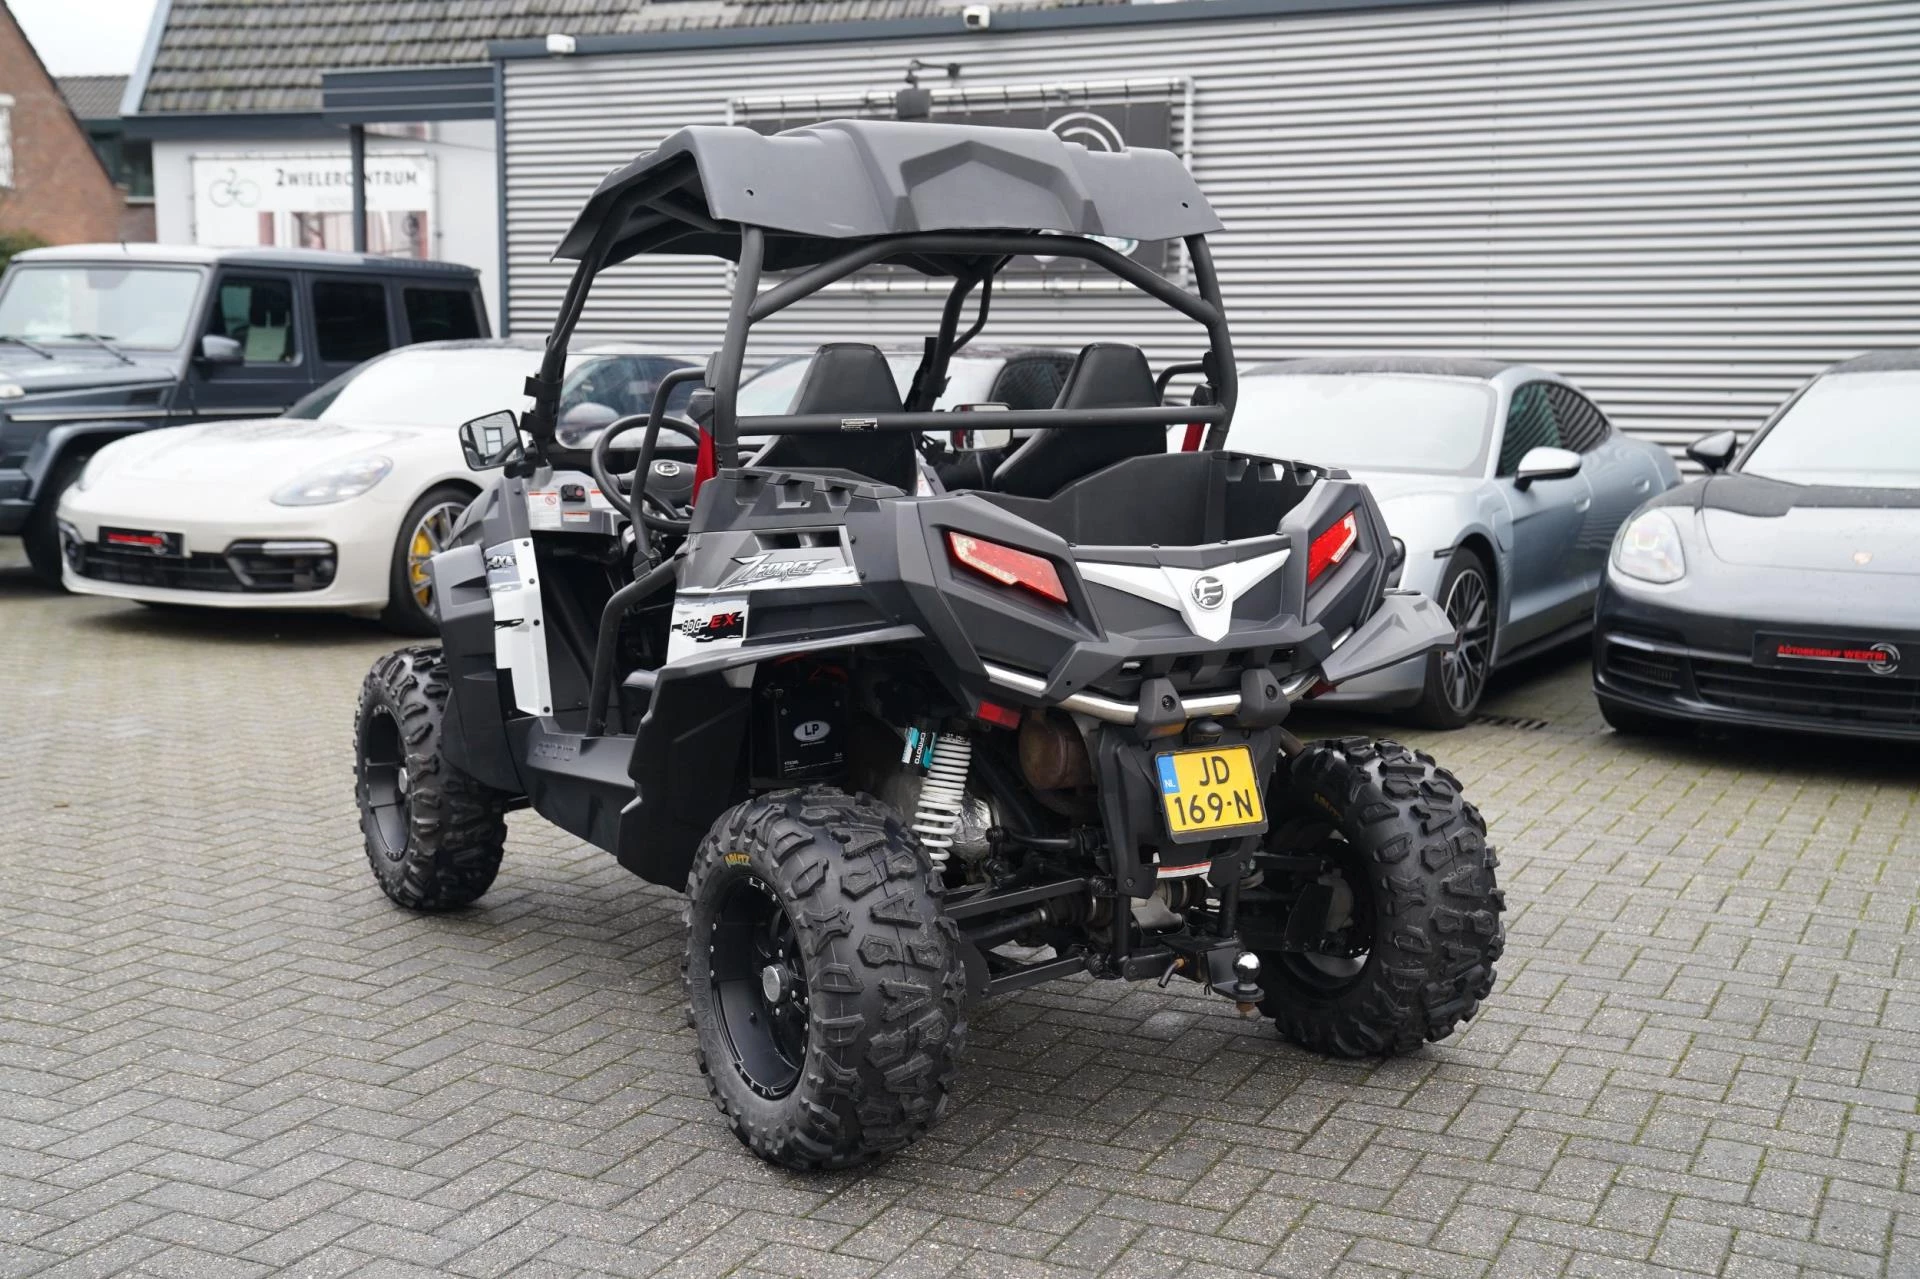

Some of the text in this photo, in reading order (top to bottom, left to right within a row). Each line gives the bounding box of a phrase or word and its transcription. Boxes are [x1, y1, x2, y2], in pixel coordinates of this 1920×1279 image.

[275, 168, 418, 187] 2WIELERCNTRUM
[804, 723, 820, 736] LP
[1199, 755, 1230, 787] JD
[1164, 779, 1176, 788] NL
